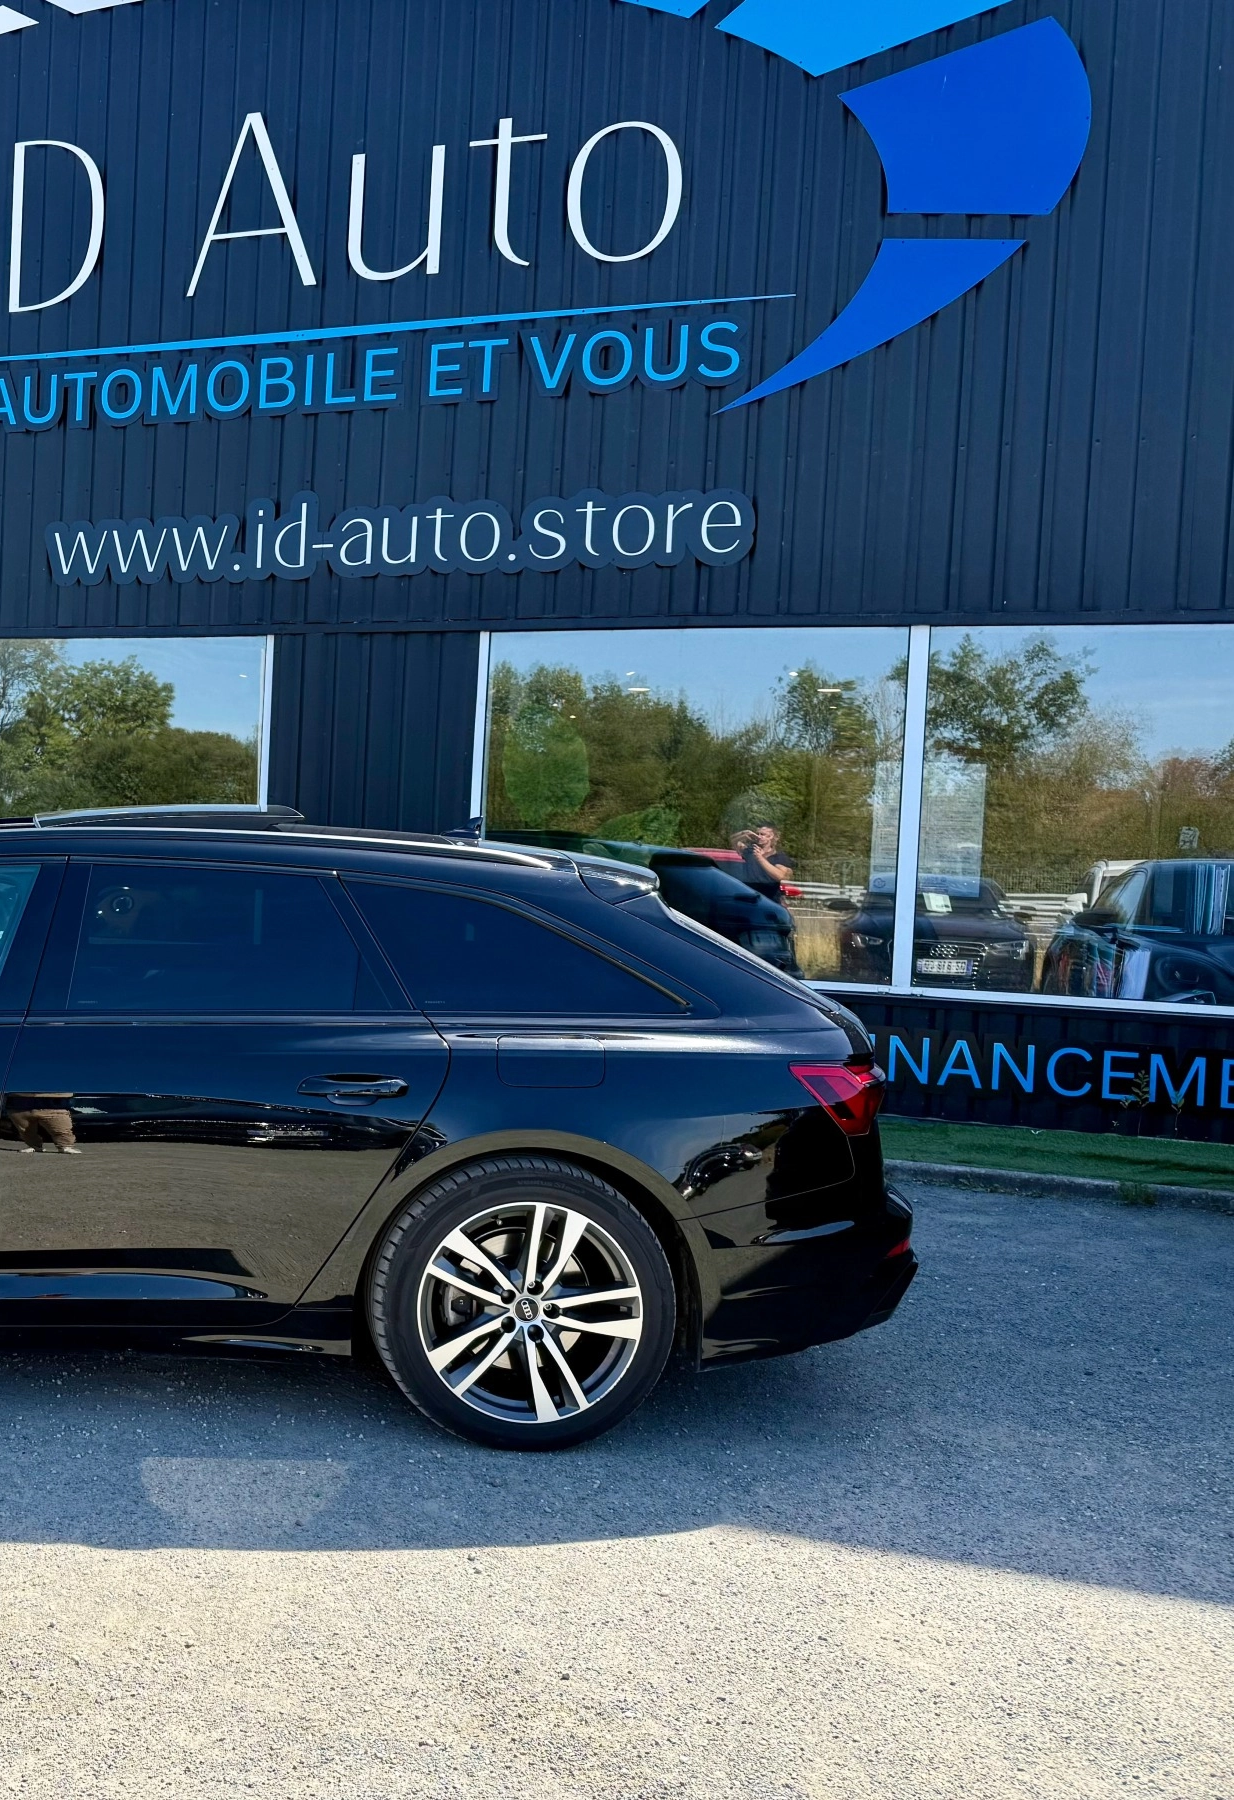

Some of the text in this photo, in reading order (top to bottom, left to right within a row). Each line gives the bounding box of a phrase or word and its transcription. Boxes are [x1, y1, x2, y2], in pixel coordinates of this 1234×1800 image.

[186, 111, 683, 297] Auto
[428, 338, 509, 397] ET
[530, 321, 740, 389] VOUS
[54, 500, 742, 576] www.id-auto.store
[869, 1034, 1234, 1109] NANCEM
